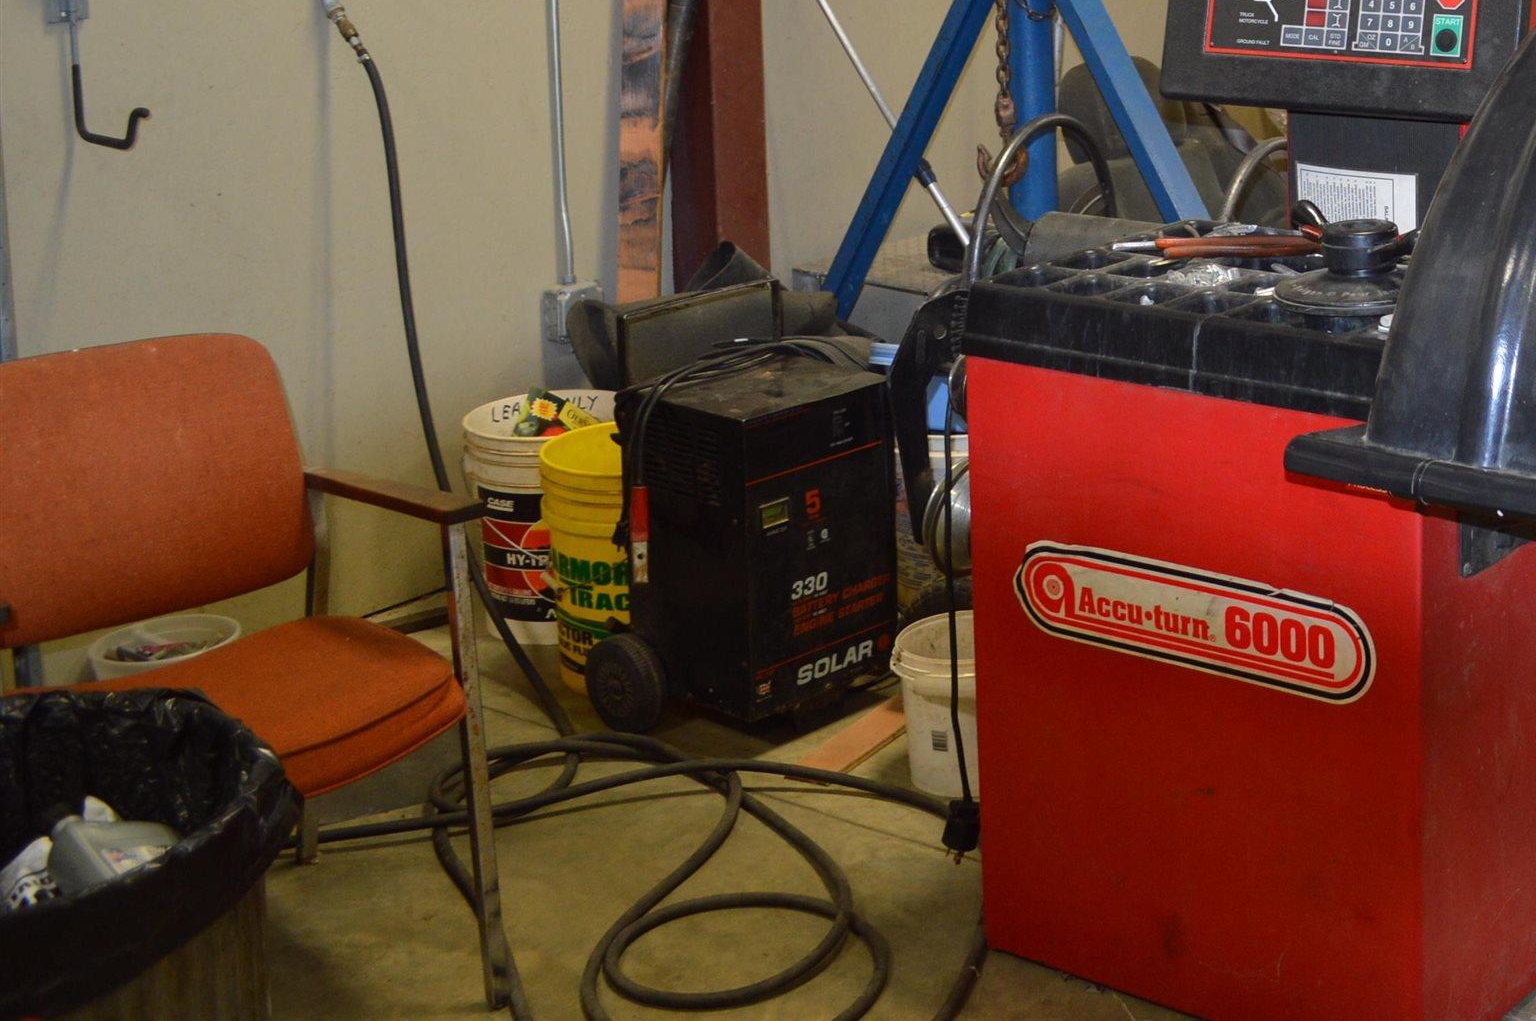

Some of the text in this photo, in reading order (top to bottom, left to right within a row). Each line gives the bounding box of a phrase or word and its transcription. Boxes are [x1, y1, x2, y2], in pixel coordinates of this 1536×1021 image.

[1368, 0, 1375, 8] 4
[1389, 1, 1395, 10] 5
[1410, 2, 1416, 11] 6
[1367, 18, 1373, 26] 7
[1387, 19, 1393, 28] 8
[1408, 21, 1414, 29] 9
[1435, 17, 1460, 26] START
[1385, 38, 1391, 46] 0
[492, 402, 521, 422] LEA
[487, 497, 514, 507] CASE
[804, 488, 823, 515] 5
[791, 571, 828, 600] 330
[792, 592, 839, 617] BATTERY
[792, 592, 886, 637] ENGINE STARTER
[1224, 605, 1335, 670] 6000
[796, 639, 873, 685] SOLAR
